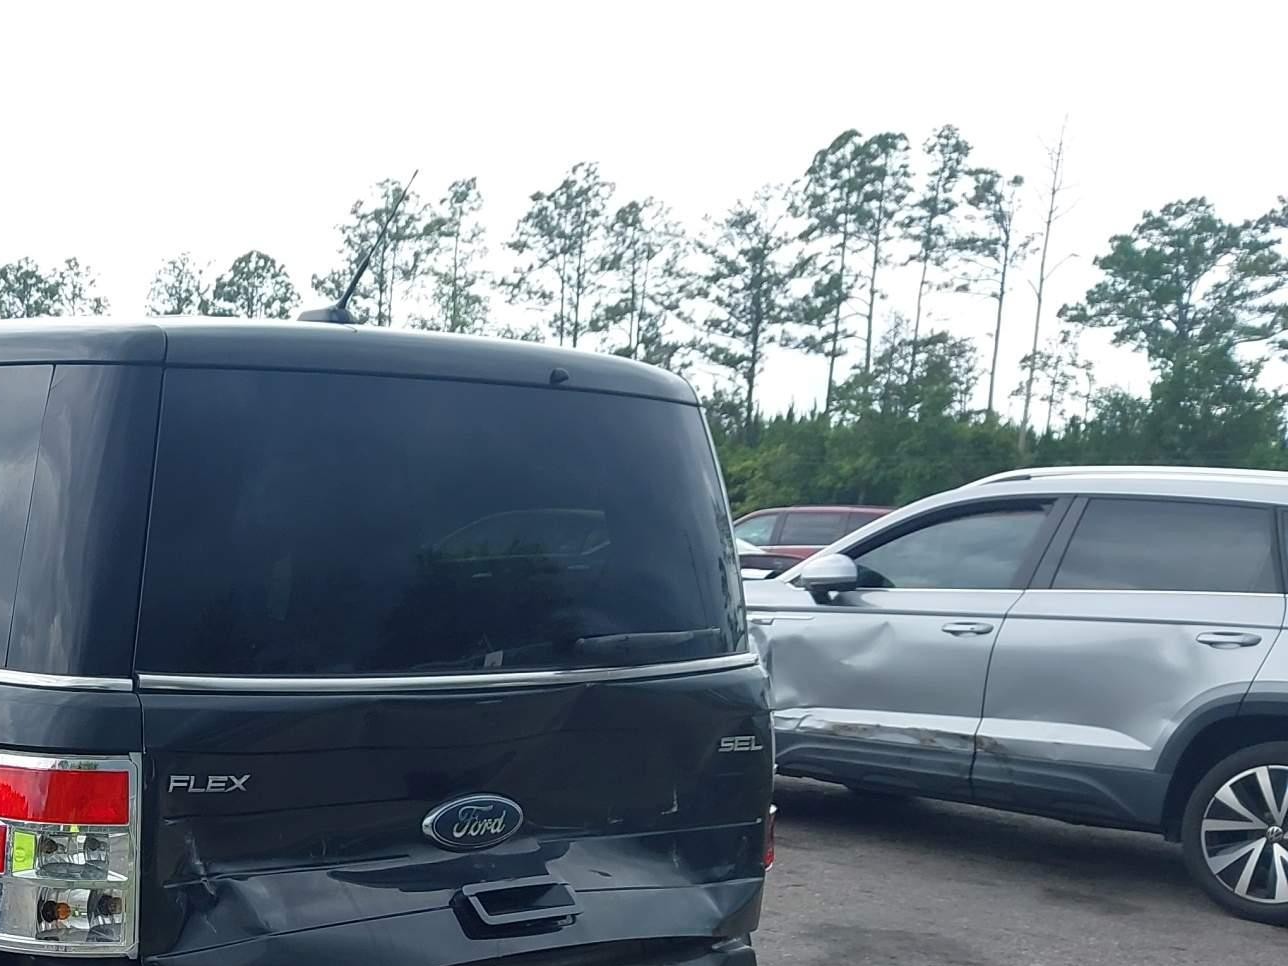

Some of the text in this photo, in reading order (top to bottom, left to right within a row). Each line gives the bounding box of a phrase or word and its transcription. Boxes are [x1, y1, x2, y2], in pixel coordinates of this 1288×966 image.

[718, 735, 763, 752] SEL
[168, 774, 251, 793] FLEX
[453, 805, 506, 838] Ford
